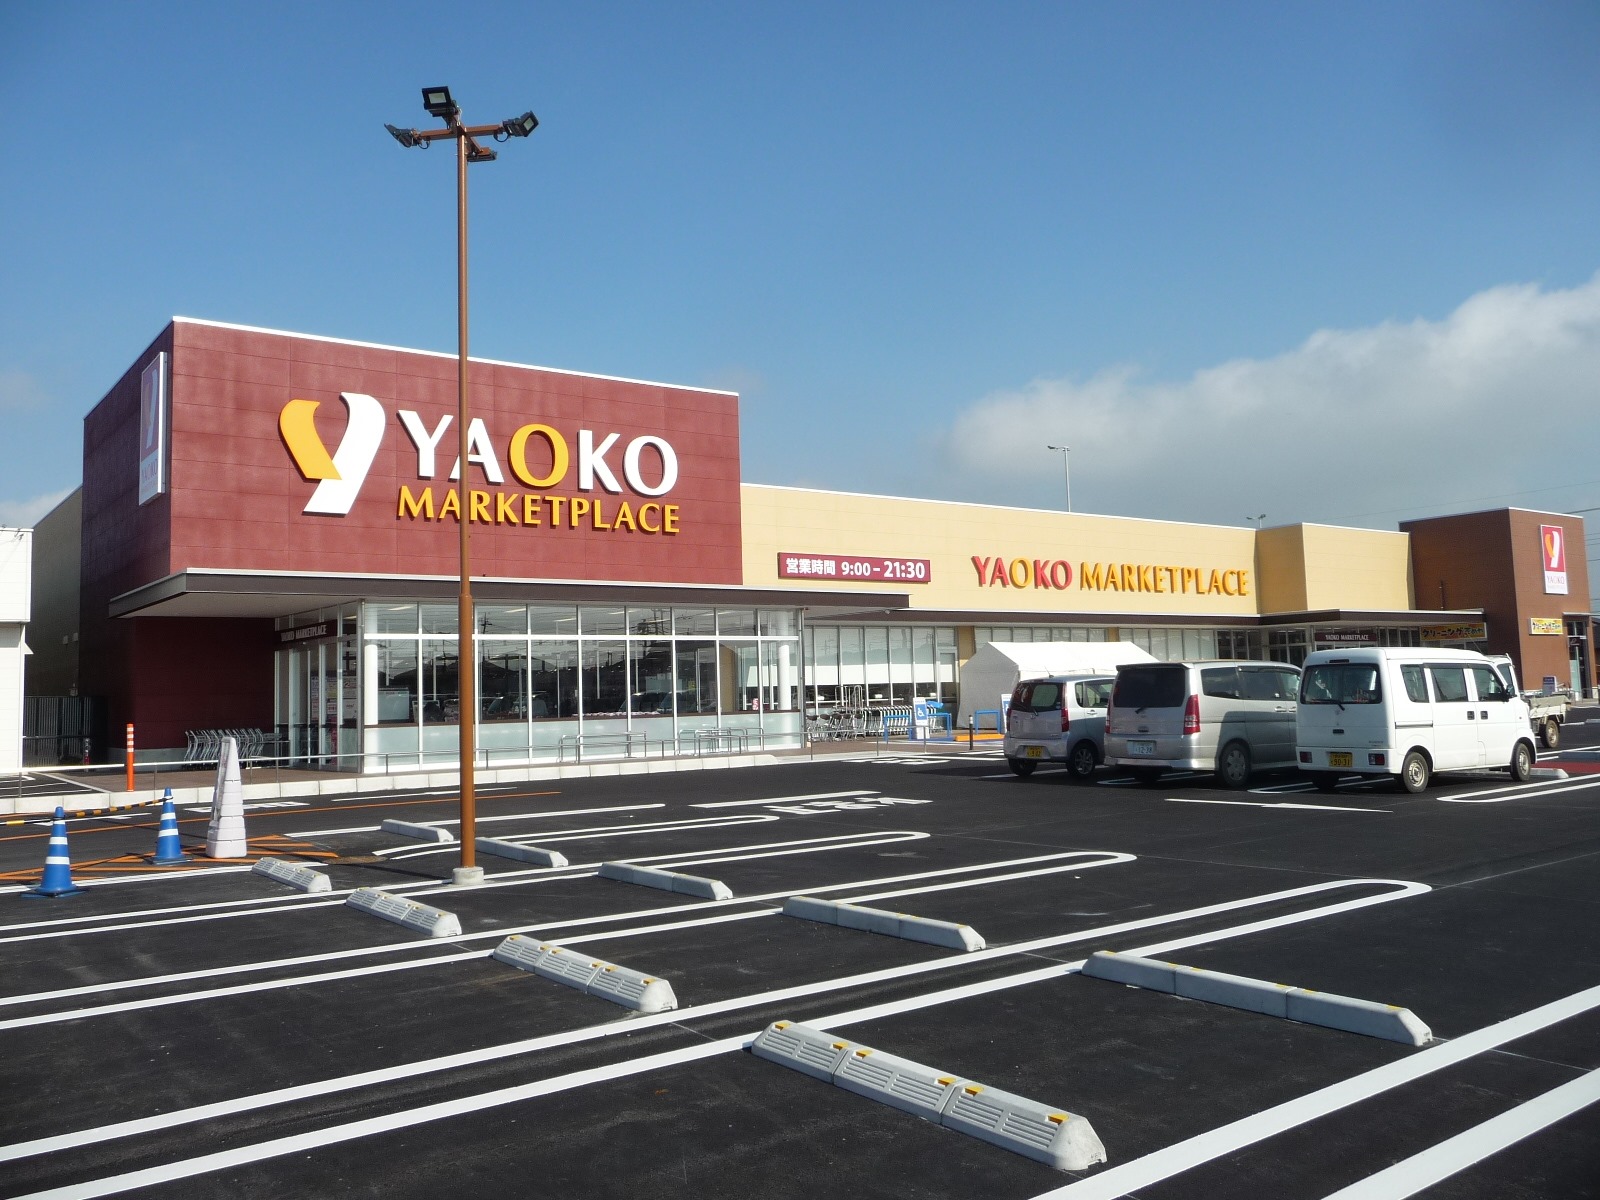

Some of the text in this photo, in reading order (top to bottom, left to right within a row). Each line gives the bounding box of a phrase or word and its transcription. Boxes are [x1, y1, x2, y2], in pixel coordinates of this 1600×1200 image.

[397, 409, 680, 498] YAOKO
[397, 485, 681, 534] MARKETPLACE
[786, 558, 836, 575] 営業時間
[971, 555, 1249, 596] YAOKO MARKETPLACE
